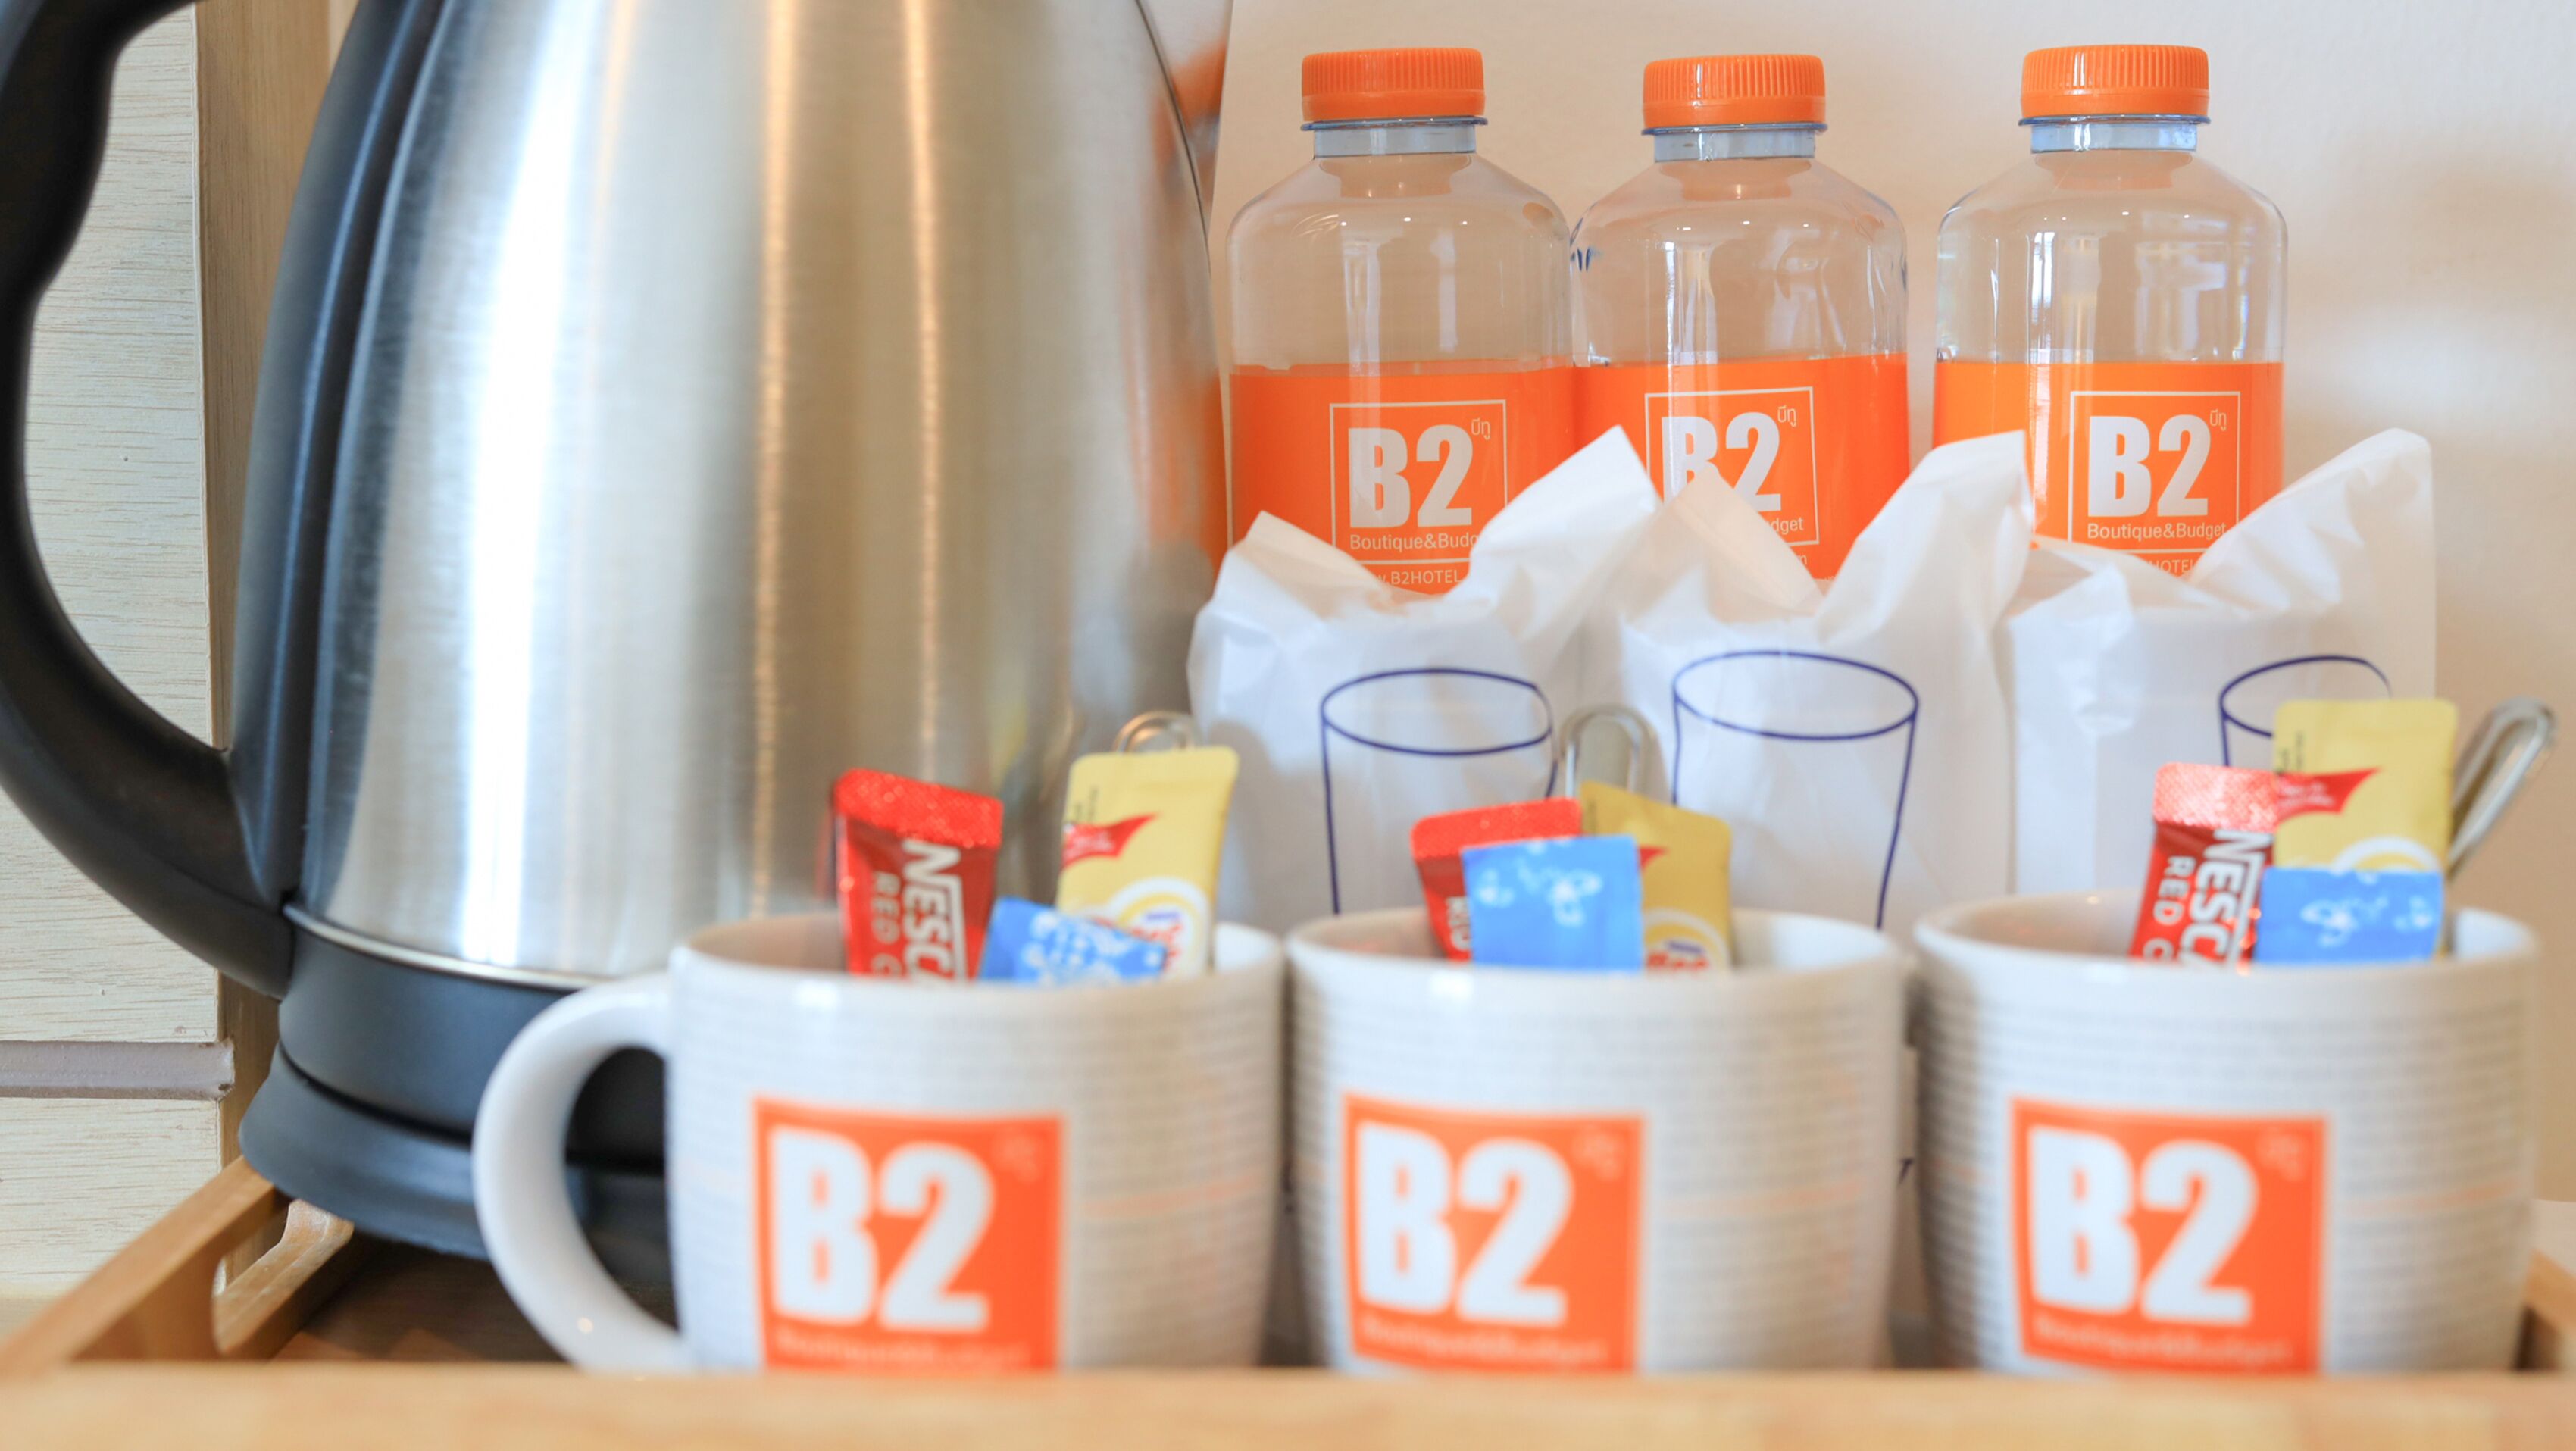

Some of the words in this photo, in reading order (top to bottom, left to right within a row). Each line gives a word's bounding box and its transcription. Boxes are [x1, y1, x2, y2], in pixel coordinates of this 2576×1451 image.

[1349, 424, 1474, 528] B2
[1662, 412, 1782, 512] B2
[2087, 414, 2211, 518] B2
[2087, 522, 2227, 541] Boutique&Budget
[2152, 856, 2196, 926] RED
[770, 1124, 995, 1332] B2
[1357, 1119, 1575, 1327] B2
[2028, 1125, 2259, 1326] B2
